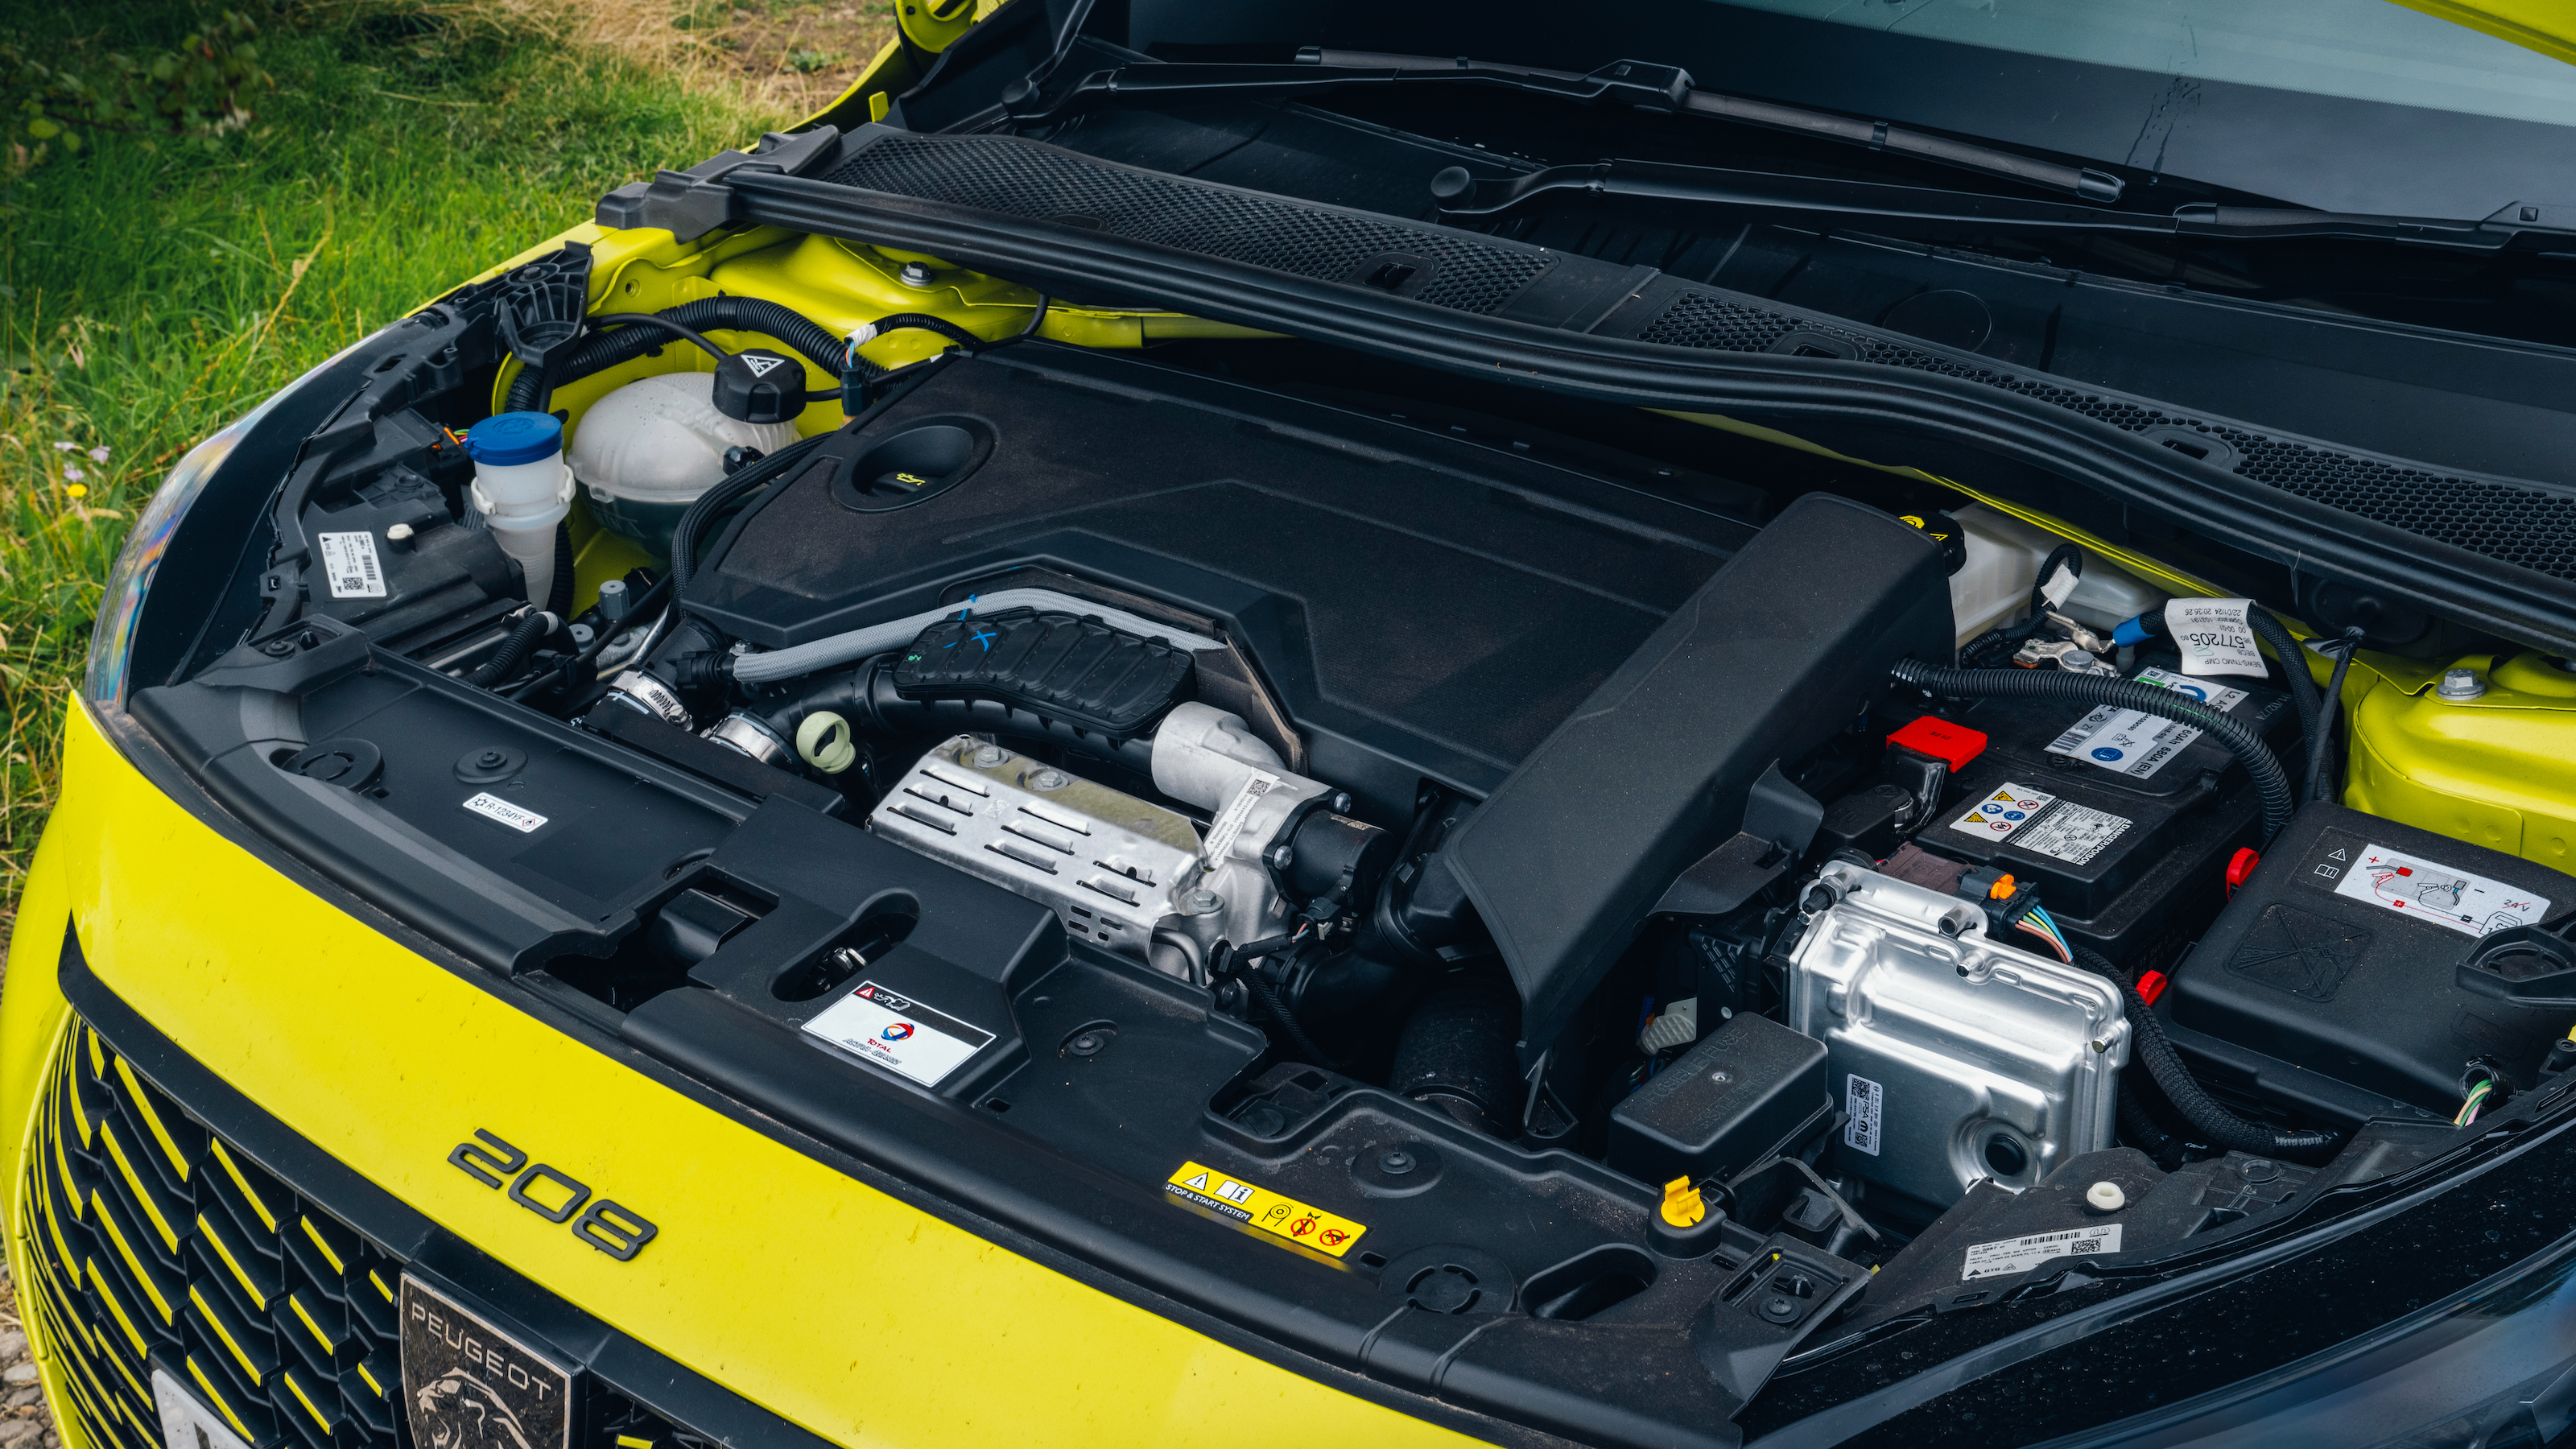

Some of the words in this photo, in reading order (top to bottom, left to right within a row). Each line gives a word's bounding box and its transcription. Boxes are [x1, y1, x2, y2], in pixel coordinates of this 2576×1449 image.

[2215, 609, 2242, 617] 22/01/24
[2169, 729, 2192, 745] 60Ah
[2147, 747, 2171, 762] 680A
[2130, 762, 2153, 775] (EN)
[485, 803, 526, 821] R-1234YF
[867, 1038, 891, 1053] TOTAL
[1862, 1100, 1870, 1118] PSA
[447, 1128, 658, 1261] 208
[1165, 1183, 1187, 1195] STOP
[1194, 1195, 1220, 1208] START
[1218, 1203, 1250, 1220] SYSTEM
[411, 1301, 551, 1401] PEUGEOT
